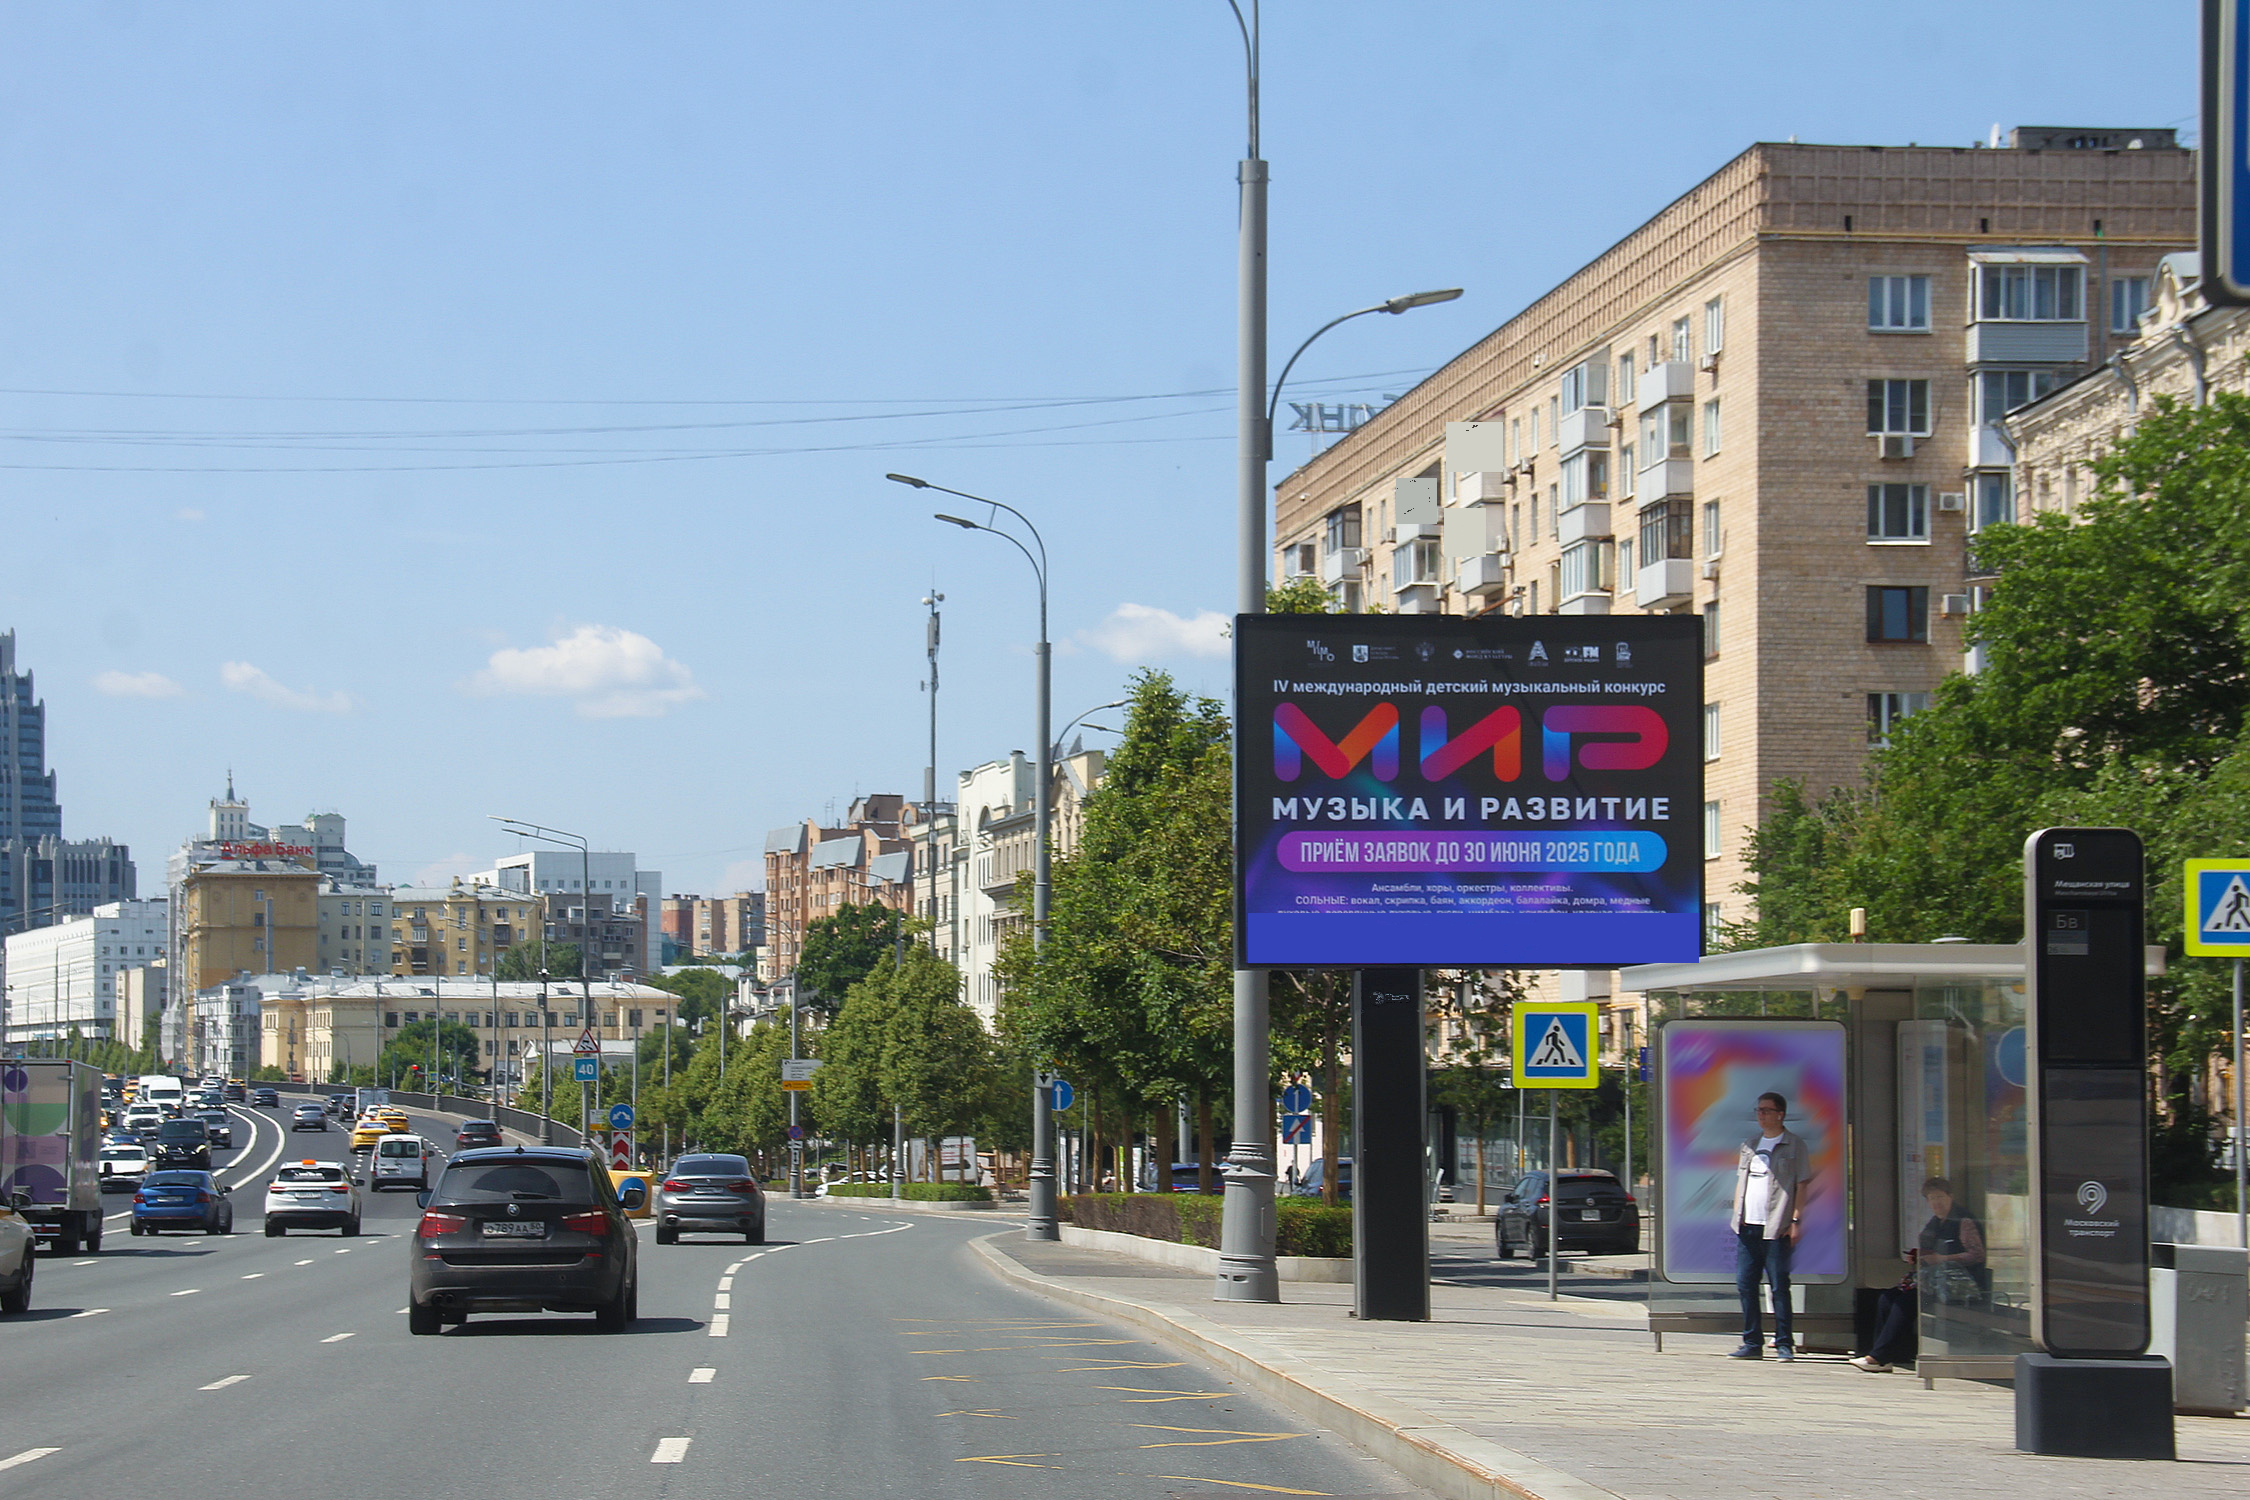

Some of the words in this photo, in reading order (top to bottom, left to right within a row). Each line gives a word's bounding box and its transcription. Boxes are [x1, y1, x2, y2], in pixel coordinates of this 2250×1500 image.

[1273, 679, 1288, 692] IV
[1293, 679, 1422, 696] международный
[1426, 679, 1488, 695] детский
[1492, 680, 1600, 696] музыкальный
[1605, 683, 1666, 696] конкурс
[1273, 702, 1669, 783] МИР
[1272, 797, 1430, 820] МУЗЫКА
[1444, 797, 1466, 820] И
[1481, 797, 1669, 821] РАЗВИТИЕ
[275, 841, 315, 856] Банк
[1301, 838, 1359, 863] ПРИЁМ
[1364, 841, 1431, 863] ЗАЯВОК
[1435, 841, 1460, 865] ДО
[1464, 841, 1486, 863] 30
[1490, 841, 1541, 863] ИЮНЯ
[1545, 841, 1590, 863] 2025
[1593, 841, 1640, 866] ГОДА
[1371, 883, 1424, 894] Ансамбли,
[1426, 885, 1455, 894] хоры,
[1456, 885, 1508, 894] оркестры,
[1509, 885, 1574, 893] коллективы.
[1295, 895, 1349, 905] СОЛЬНЫЕ:
[1350, 898, 1383, 906] вокал,
[1384, 898, 1427, 907] скрипка,
[1430, 896, 1457, 906] баян,
[1458, 898, 1514, 907] аккордеон,
[1515, 896, 1571, 906] балалайка,
[1572, 898, 1608, 907] домра,
[1609, 898, 1651, 907] медные
[2056, 914, 2079, 929] Бв
[578, 1064, 594, 1075] 40
[2064, 1219, 2120, 1228] Московский
[2068, 1229, 2116, 1238] транспорт
